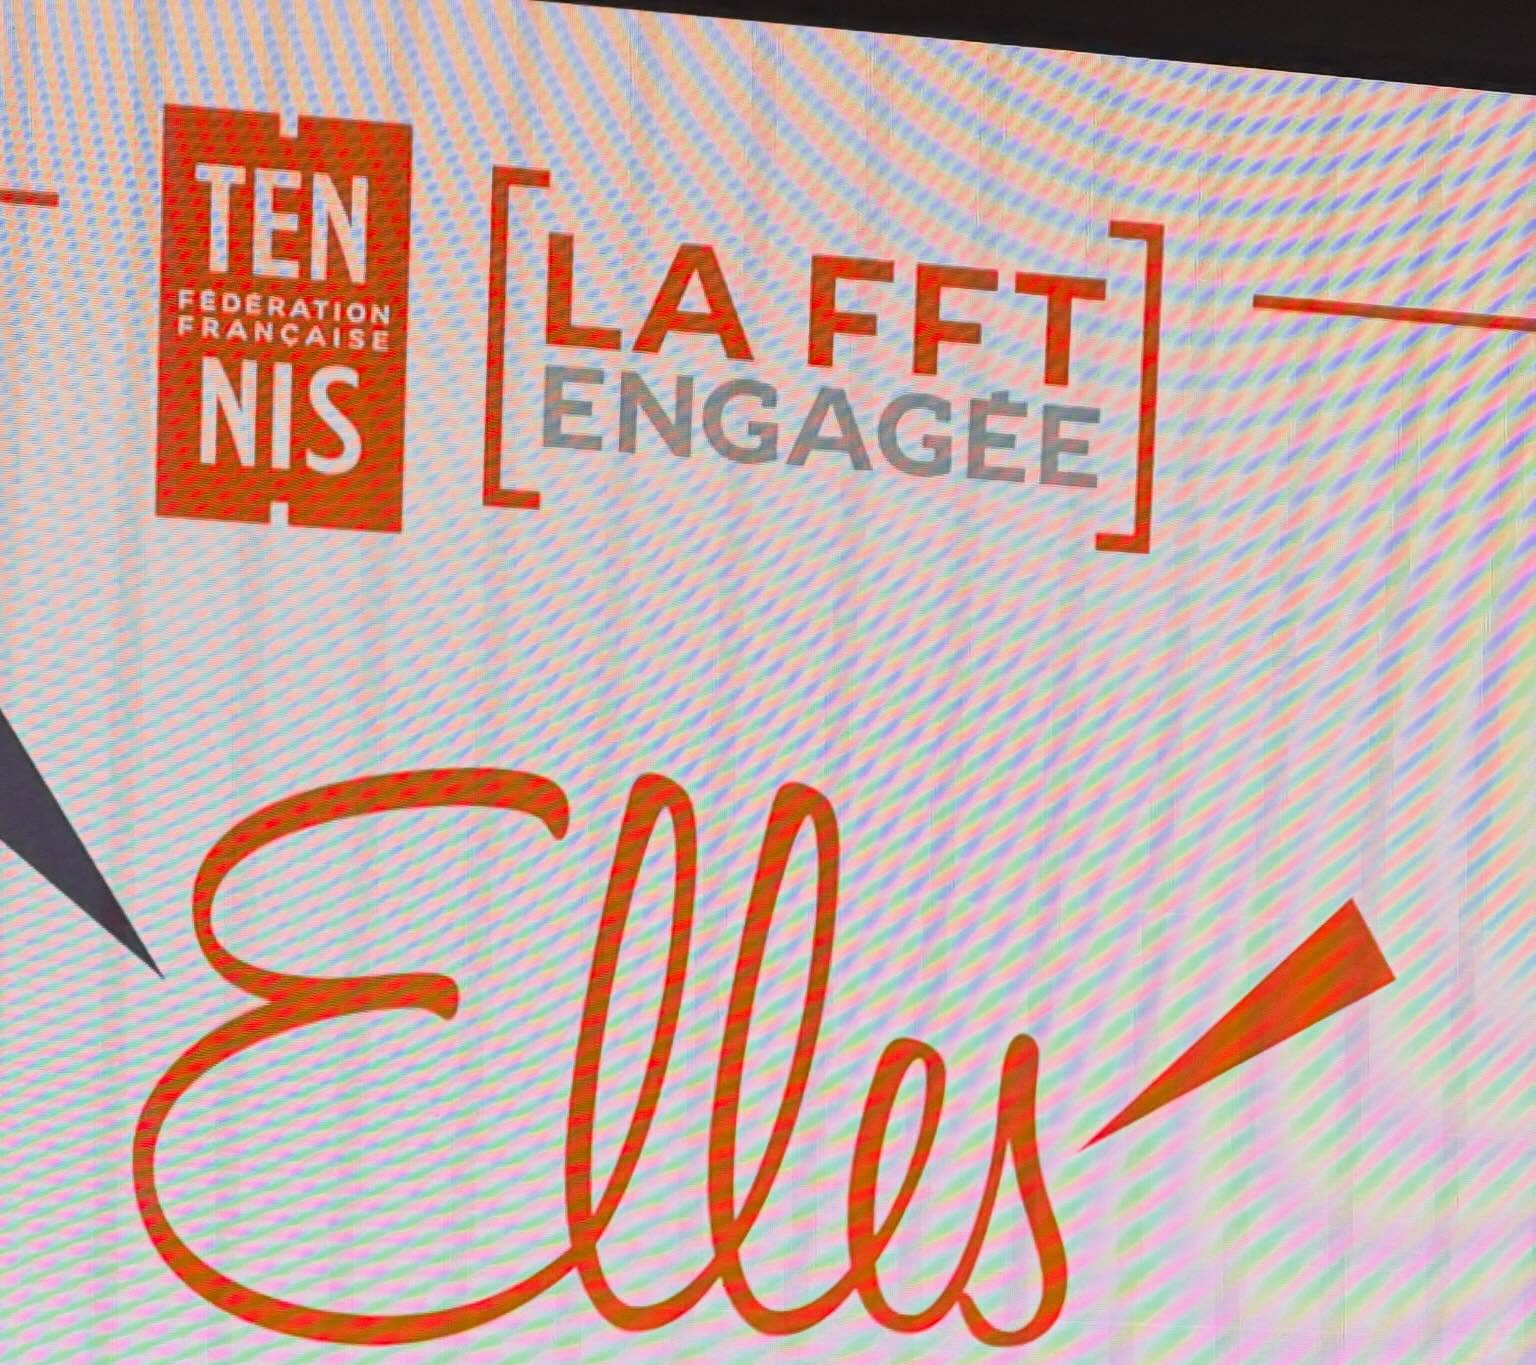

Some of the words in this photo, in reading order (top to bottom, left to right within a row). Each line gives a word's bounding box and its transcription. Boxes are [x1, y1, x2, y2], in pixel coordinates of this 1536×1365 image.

[195, 164, 368, 283] TEN
[177, 314, 390, 352] FRANÇAISE
[542, 233, 753, 361] LA
[805, 253, 1106, 386] FFT
[200, 357, 362, 474] NIS
[131, 766, 1069, 1347] Elles
